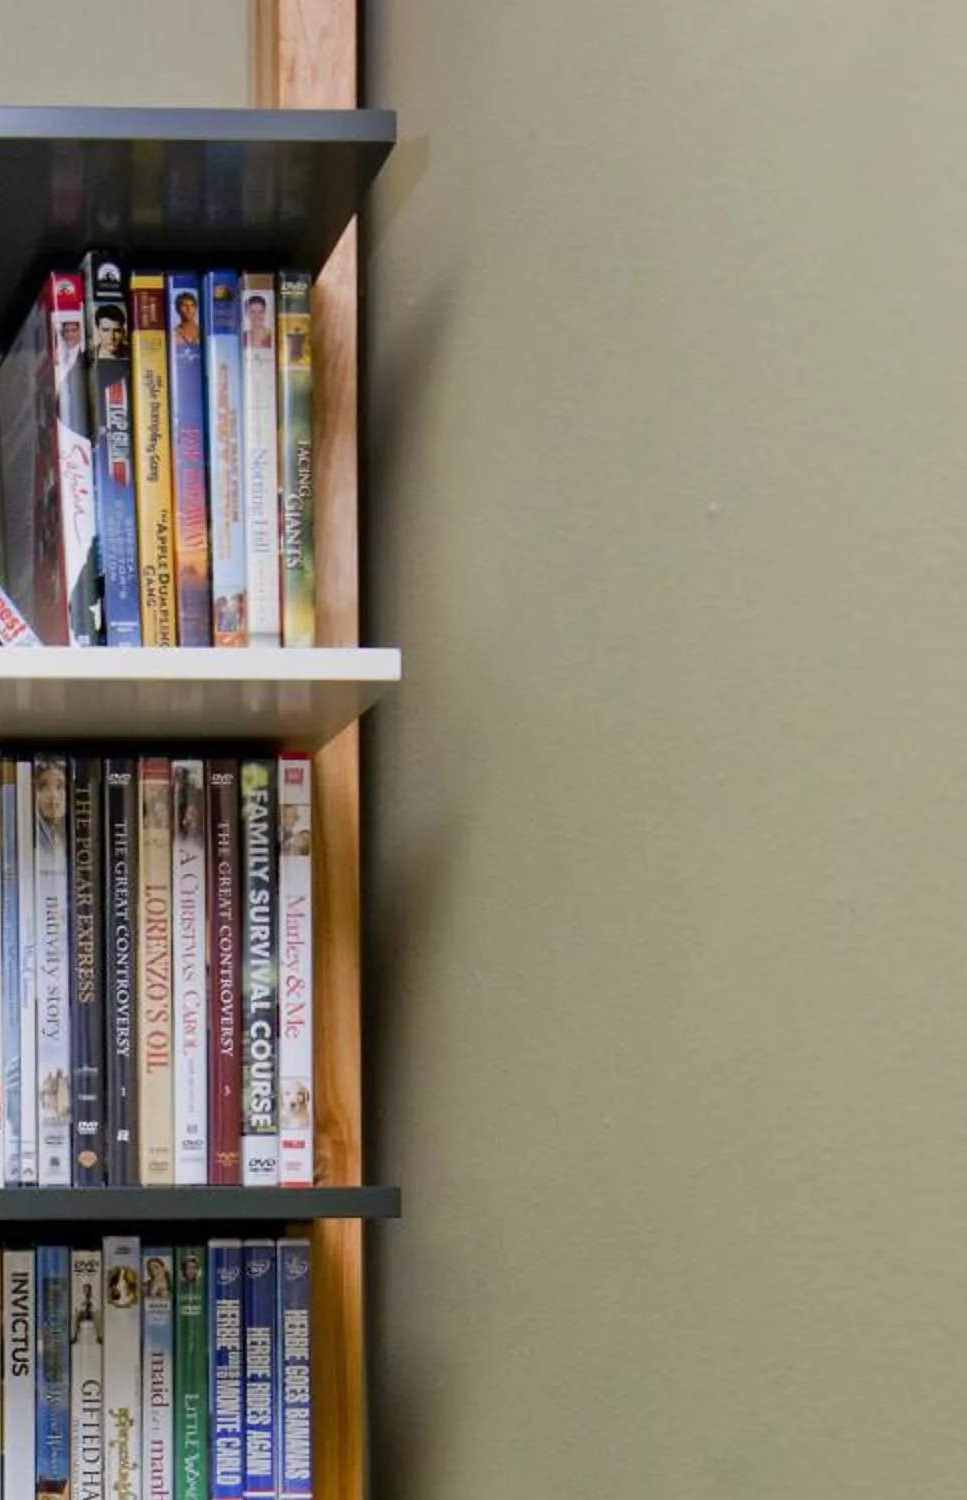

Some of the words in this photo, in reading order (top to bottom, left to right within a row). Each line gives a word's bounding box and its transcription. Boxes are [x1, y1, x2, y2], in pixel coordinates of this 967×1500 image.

[108, 404, 127, 431] TOP
[249, 450, 270, 513] Notting
[252, 519, 270, 553] Hill
[285, 494, 301, 568] GIANTS
[144, 566, 156, 607] GANG
[77, 784, 91, 831] THE
[115, 821, 128, 857] THE
[179, 849, 196, 865] A
[219, 822, 231, 854] THE
[249, 790, 269, 881] FAMILY
[77, 835, 93, 905] POLAR
[116, 861, 129, 920] GREAT
[219, 861, 232, 920] GREAT
[40, 897, 63, 976] nativity
[145, 884, 168, 1022] LORENZO'S
[180, 873, 199, 982] CHRISTMAS
[250, 890, 271, 1013] SURVIVAL
[283, 895, 308, 973] Marley
[78, 914, 94, 1003] EXPRESS
[286, 977, 307, 994] &
[41, 986, 63, 1040] story
[116, 925, 130, 1057] CONTROVERSY
[219, 926, 233, 1057] CONTROVERSY
[182, 990, 200, 1053] CAROL
[286, 1003, 307, 1039] Me
[147, 1031, 169, 1073] OIL
[251, 1019, 272, 1126] COURSE
[10, 1272, 29, 1377] INVICTUS
[216, 1300, 240, 1350] HERBIE
[284, 1310, 309, 1359] HERBIE
[246, 1328, 271, 1377] HERBIE
[150, 1353, 169, 1408] maid
[216, 1380, 241, 1432] MONTE
[246, 1383, 271, 1425] RIDES
[284, 1366, 309, 1402] GOES
[81, 1380, 101, 1464] GIFTED
[184, 1394, 200, 1450] LITTLE
[285, 1408, 310, 1479] BANANAS
[217, 1437, 241, 1485] CARLO
[247, 1431, 271, 1475] AGAIN
